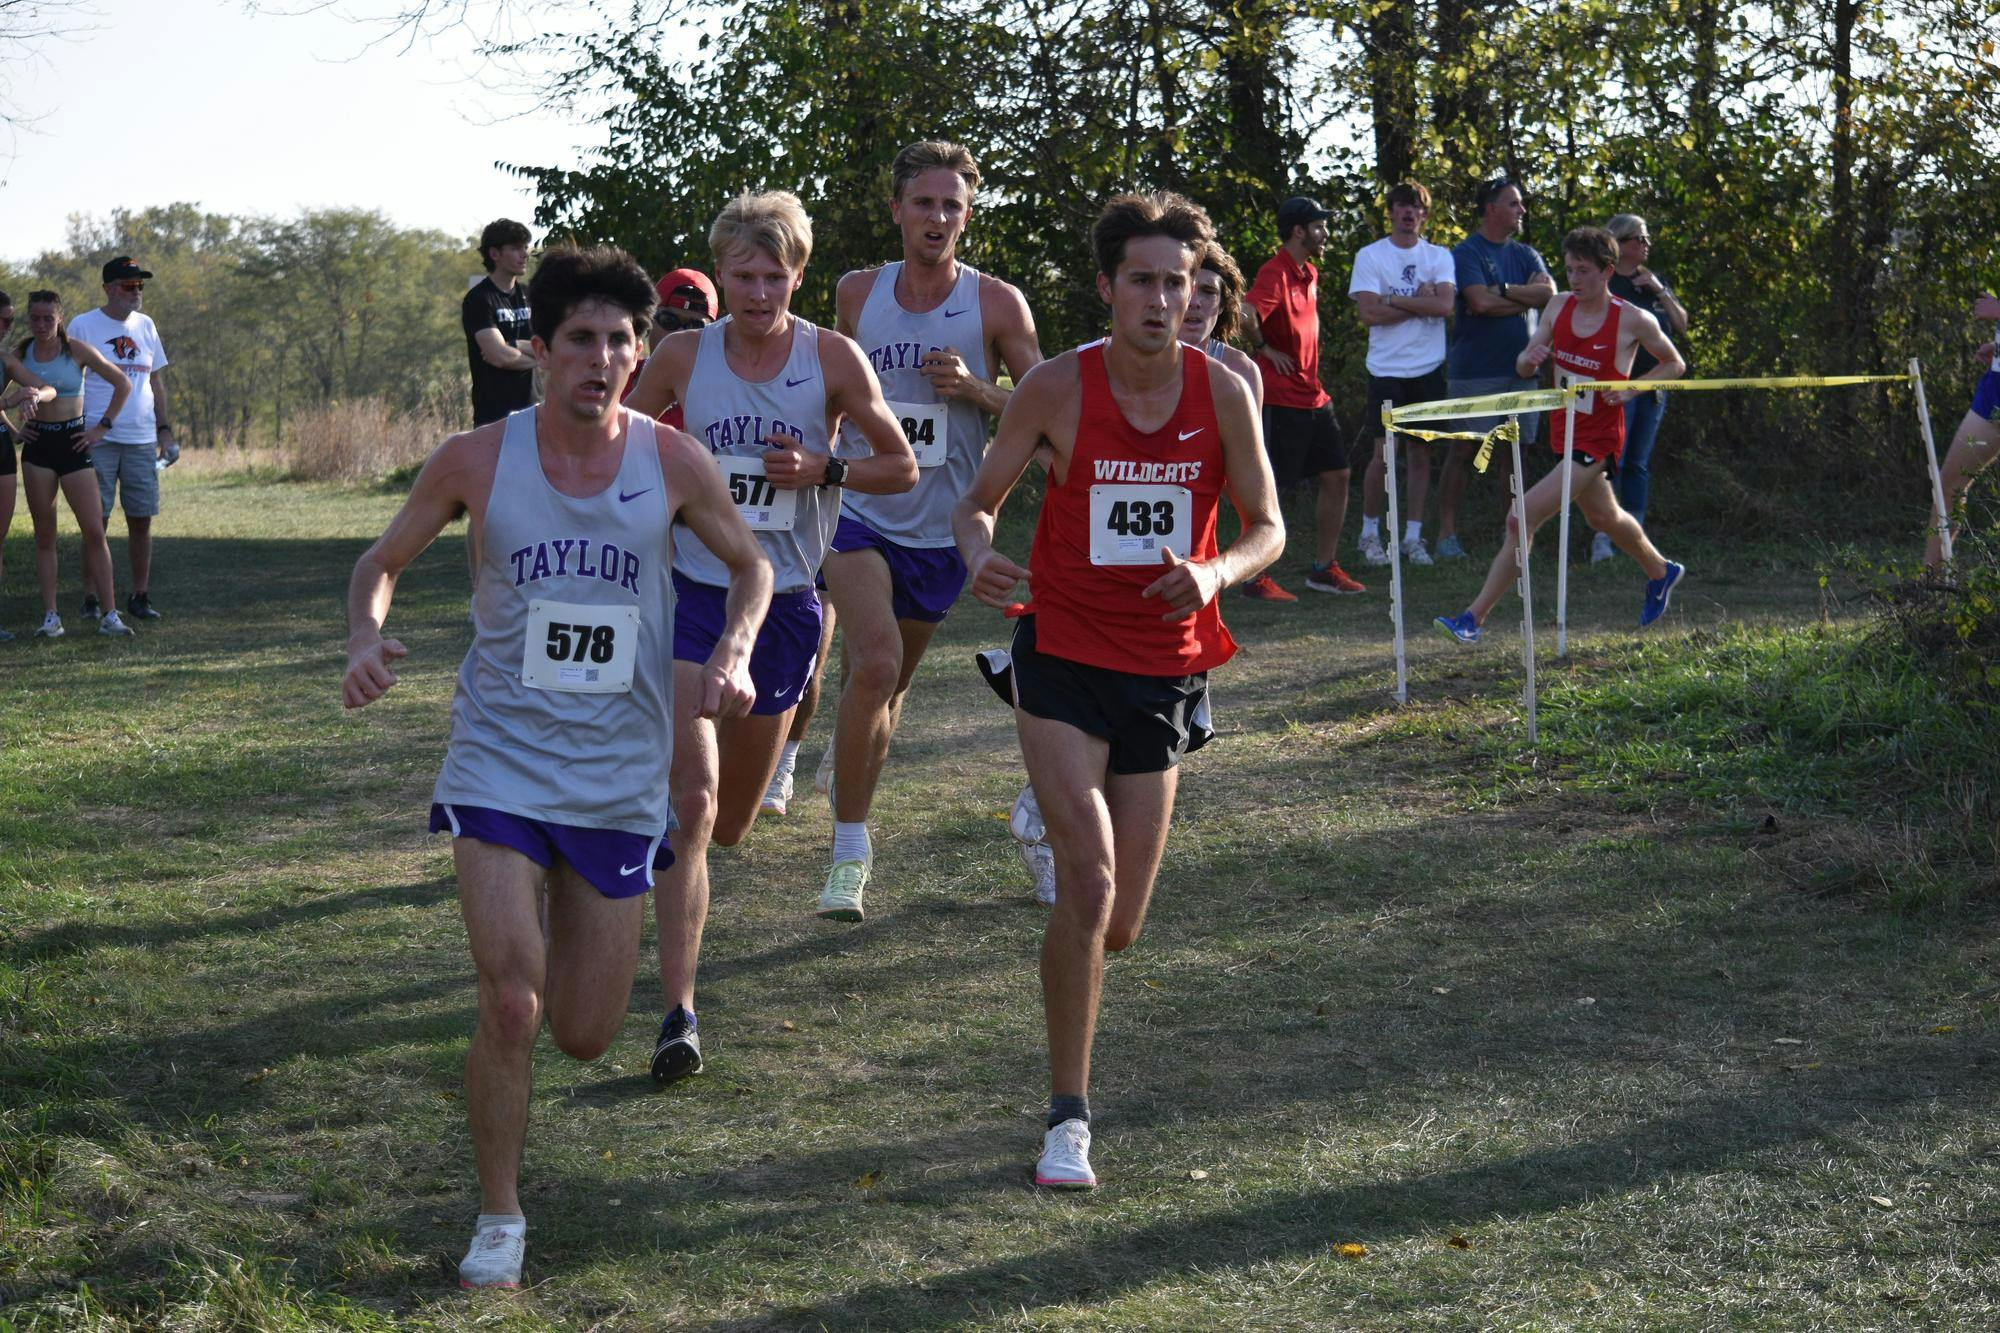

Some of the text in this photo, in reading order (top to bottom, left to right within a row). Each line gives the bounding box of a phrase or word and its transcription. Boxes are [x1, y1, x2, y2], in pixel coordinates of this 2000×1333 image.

[897, 416, 936, 446] 84
[1093, 459, 1202, 483] WILDCATS
[1107, 500, 1175, 536] 433
[510, 538, 641, 598] TAYLOR
[546, 621, 616, 664] 578
